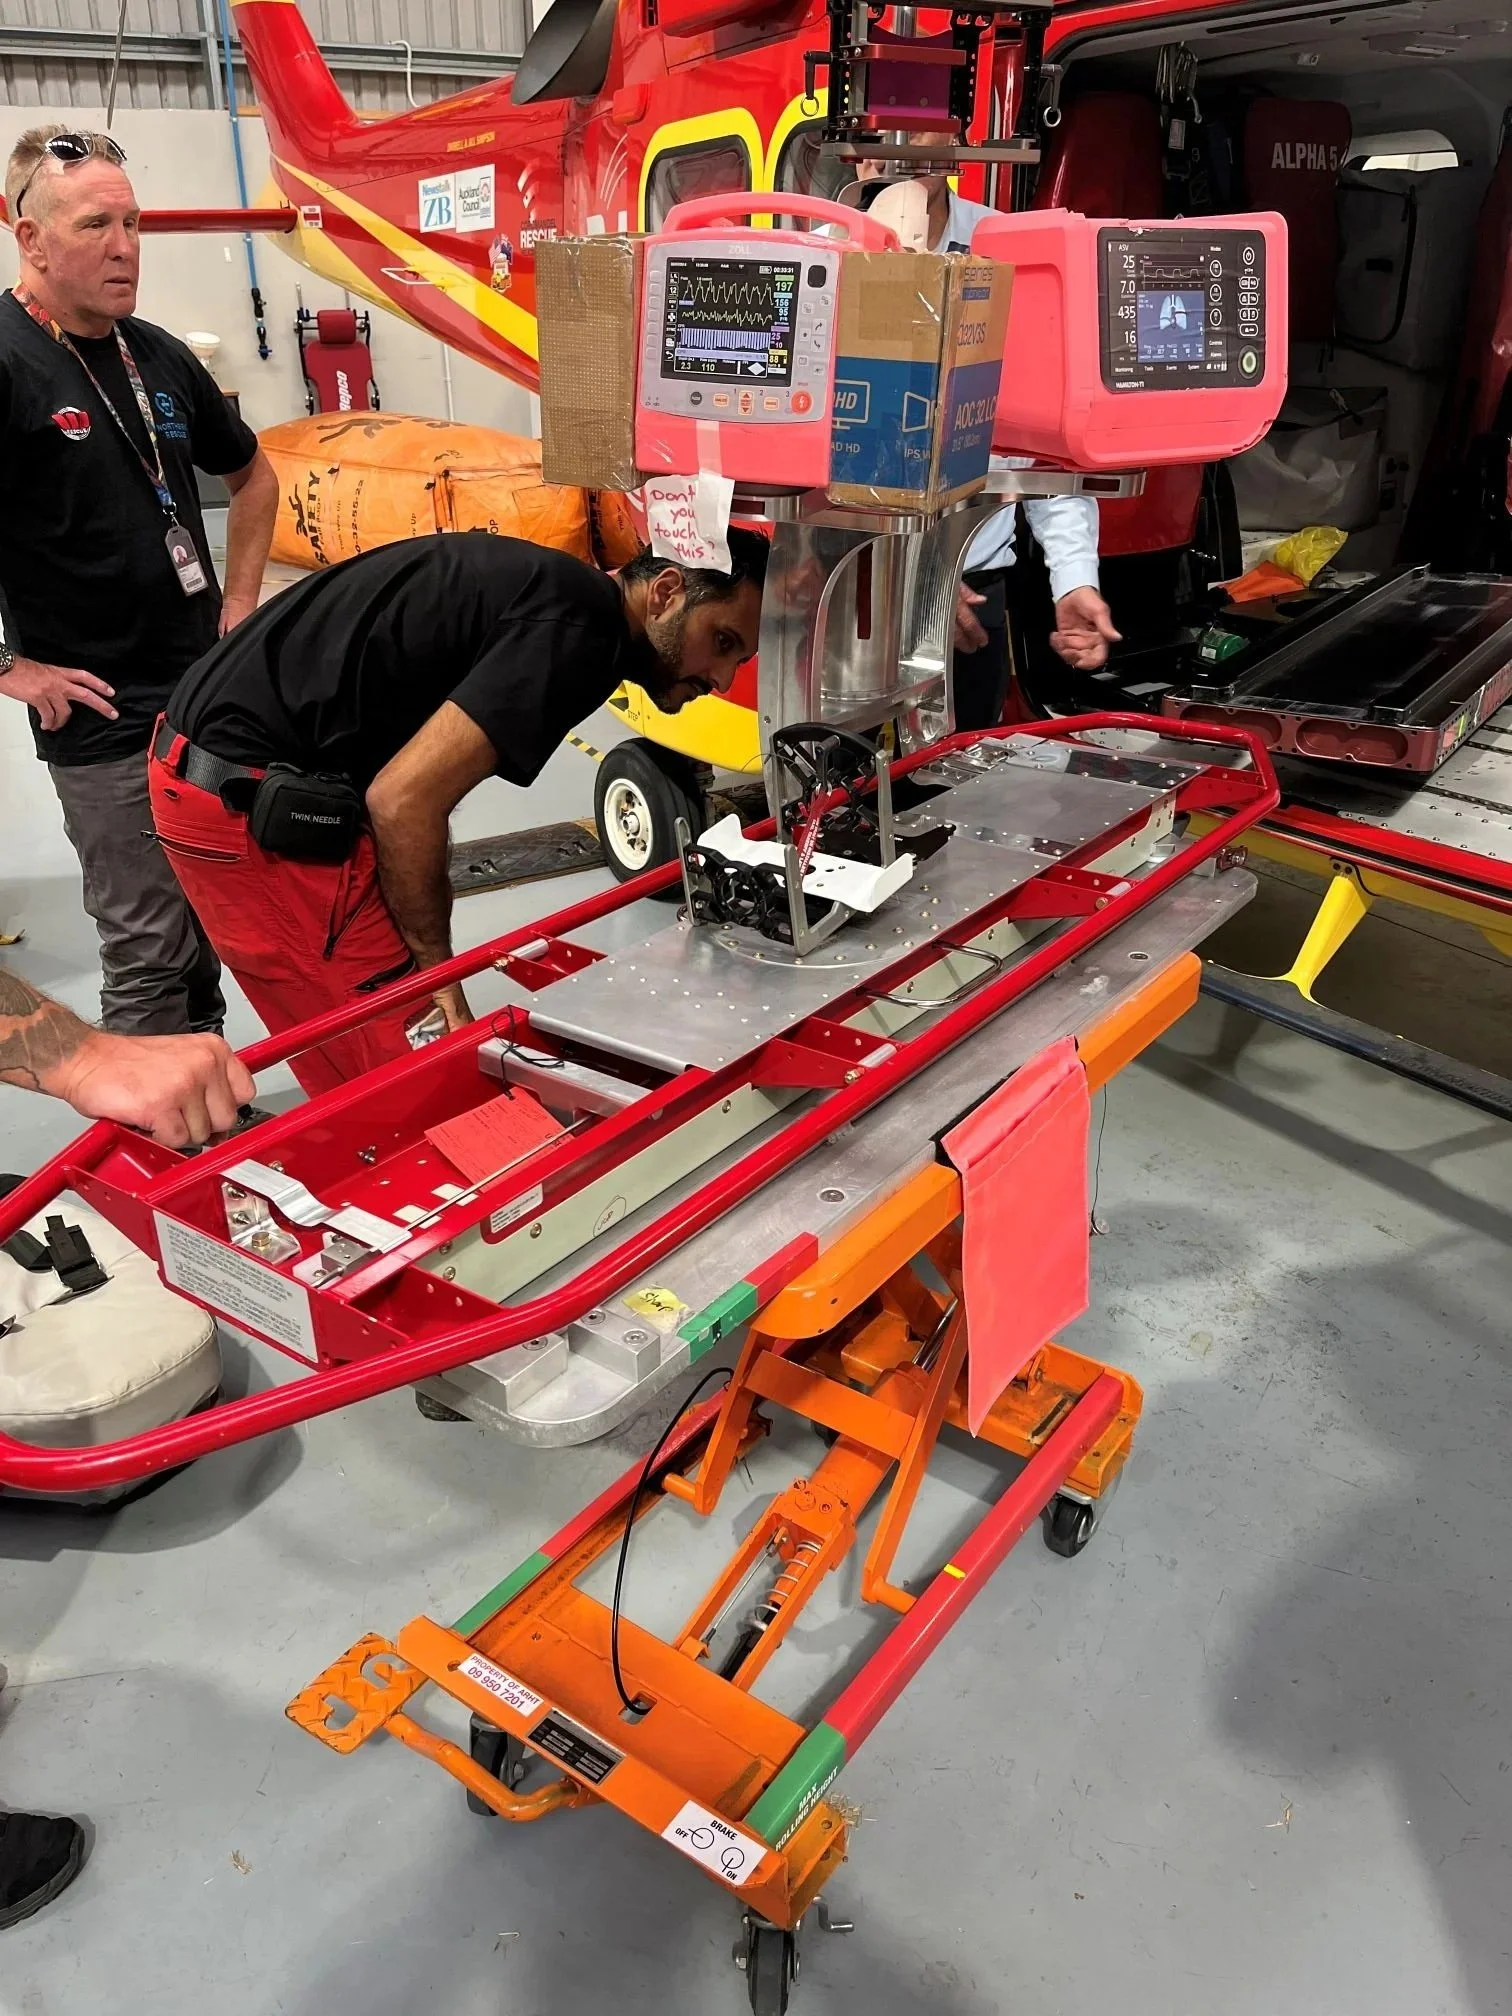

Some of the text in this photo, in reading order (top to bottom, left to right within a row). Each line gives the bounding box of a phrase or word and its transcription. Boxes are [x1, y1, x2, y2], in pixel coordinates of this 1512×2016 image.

[1271, 142, 1338, 172] ALPHA 5
[459, 185, 480, 200] Auckland
[424, 196, 452, 227] ZB
[462, 198, 480, 213] Council
[728, 244, 752, 255] ZOLL
[1118, 244, 1129, 252] ASV
[1122, 255, 1136, 269] 25
[775, 281, 793, 292] 197
[1120, 280, 1136, 294] 7.0
[774, 299, 789, 307] 156
[778, 308, 789, 316] 95
[1118, 305, 1136, 320] 435
[771, 332, 781, 341] 25
[1124, 330, 1137, 344] 16
[680, 361, 691, 370] 2.3
[769, 355, 779, 364] 88
[701, 363, 715, 372] 110
[833, 391, 858, 410] HD
[954, 401, 976, 431] AOC
[975, 399, 986, 425] 32
[845, 443, 861, 453] HD
[904, 448, 921, 459] IPS
[308, 470, 330, 565] SAFETY
[670, 508, 696, 525] you
[654, 521, 697, 540] touch
[291, 811, 341, 825] TWIN NEEDLE
[470, 1655, 540, 1705] PROPERTY OF ARHT
[467, 1666, 526, 1709] 09 950 7201
[799, 1783, 818, 1810] MAX
[775, 1766, 838, 1852] ROLLING HEIGHT
[674, 1827, 690, 1839] OFF
[710, 1819, 738, 1841] BRAKE
[726, 1870, 738, 1881] ON
